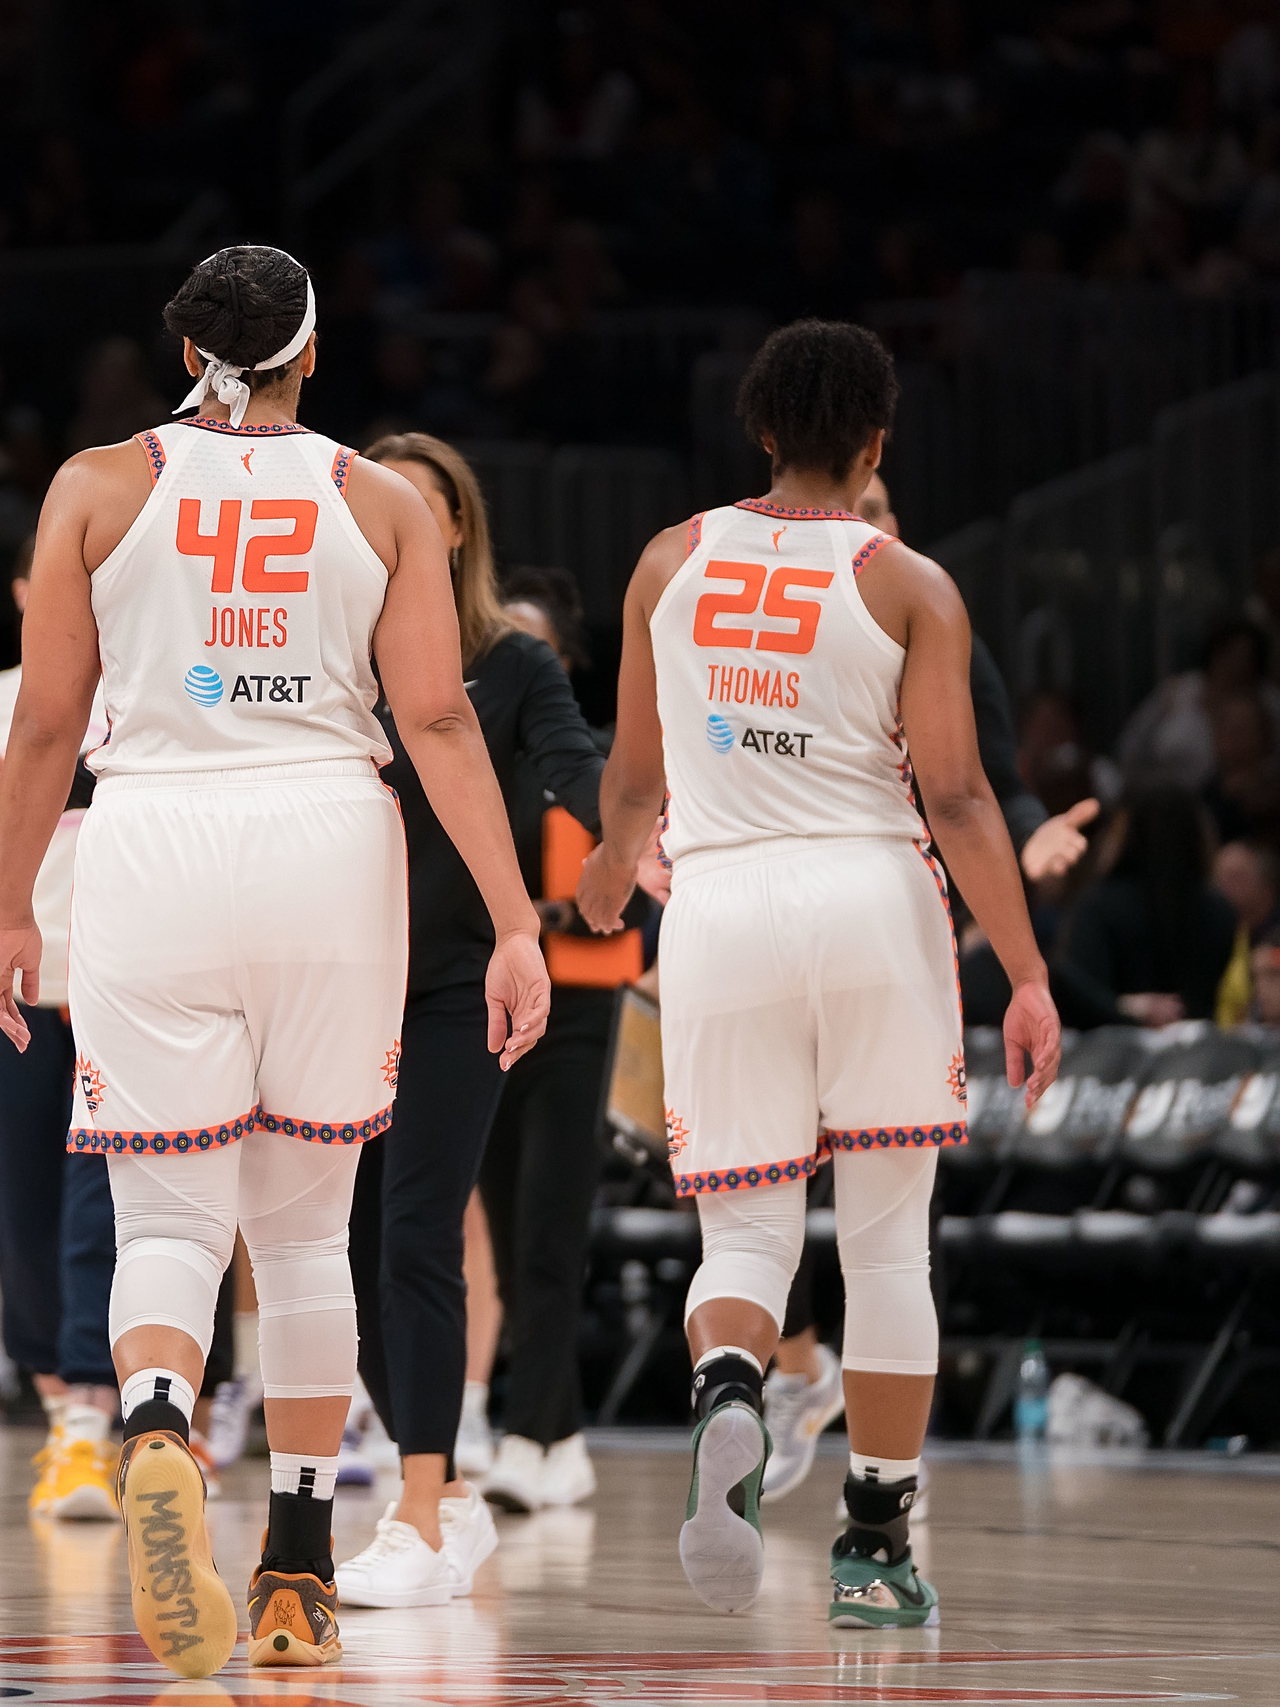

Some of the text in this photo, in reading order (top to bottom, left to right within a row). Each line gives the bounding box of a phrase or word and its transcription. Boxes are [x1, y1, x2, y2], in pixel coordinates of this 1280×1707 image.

[176, 499, 319, 594] 42
[204, 606, 288, 648] JONES
[692, 560, 835, 655] 25
[230, 674, 311, 703] AT&T
[708, 664, 800, 709] THOMAS
[741, 727, 814, 758] AT&T
[135, 1489, 206, 1658] MONSTA
